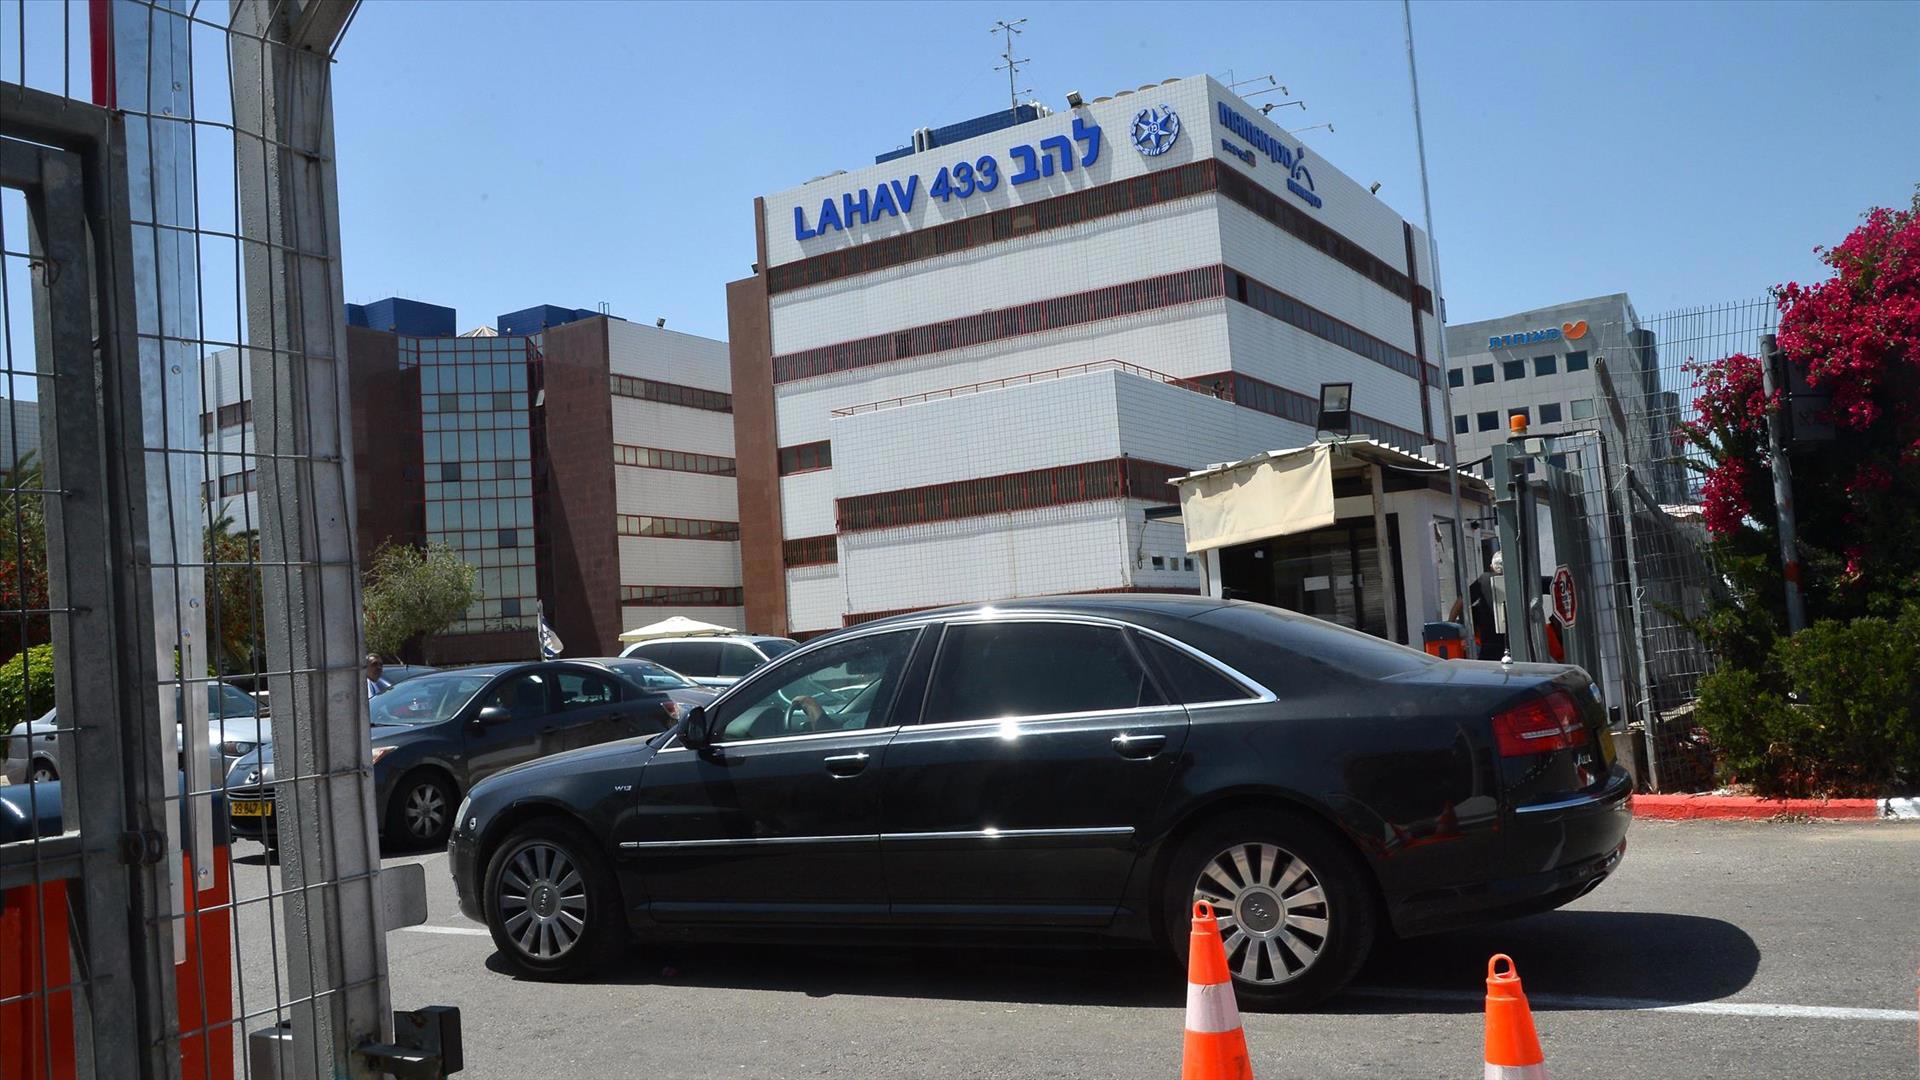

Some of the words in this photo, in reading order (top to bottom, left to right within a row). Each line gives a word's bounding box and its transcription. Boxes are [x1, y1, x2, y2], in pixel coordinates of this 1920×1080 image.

[1009, 117, 1101, 186] להב
[793, 174, 918, 241] LAHAV
[929, 154, 998, 202] 433
